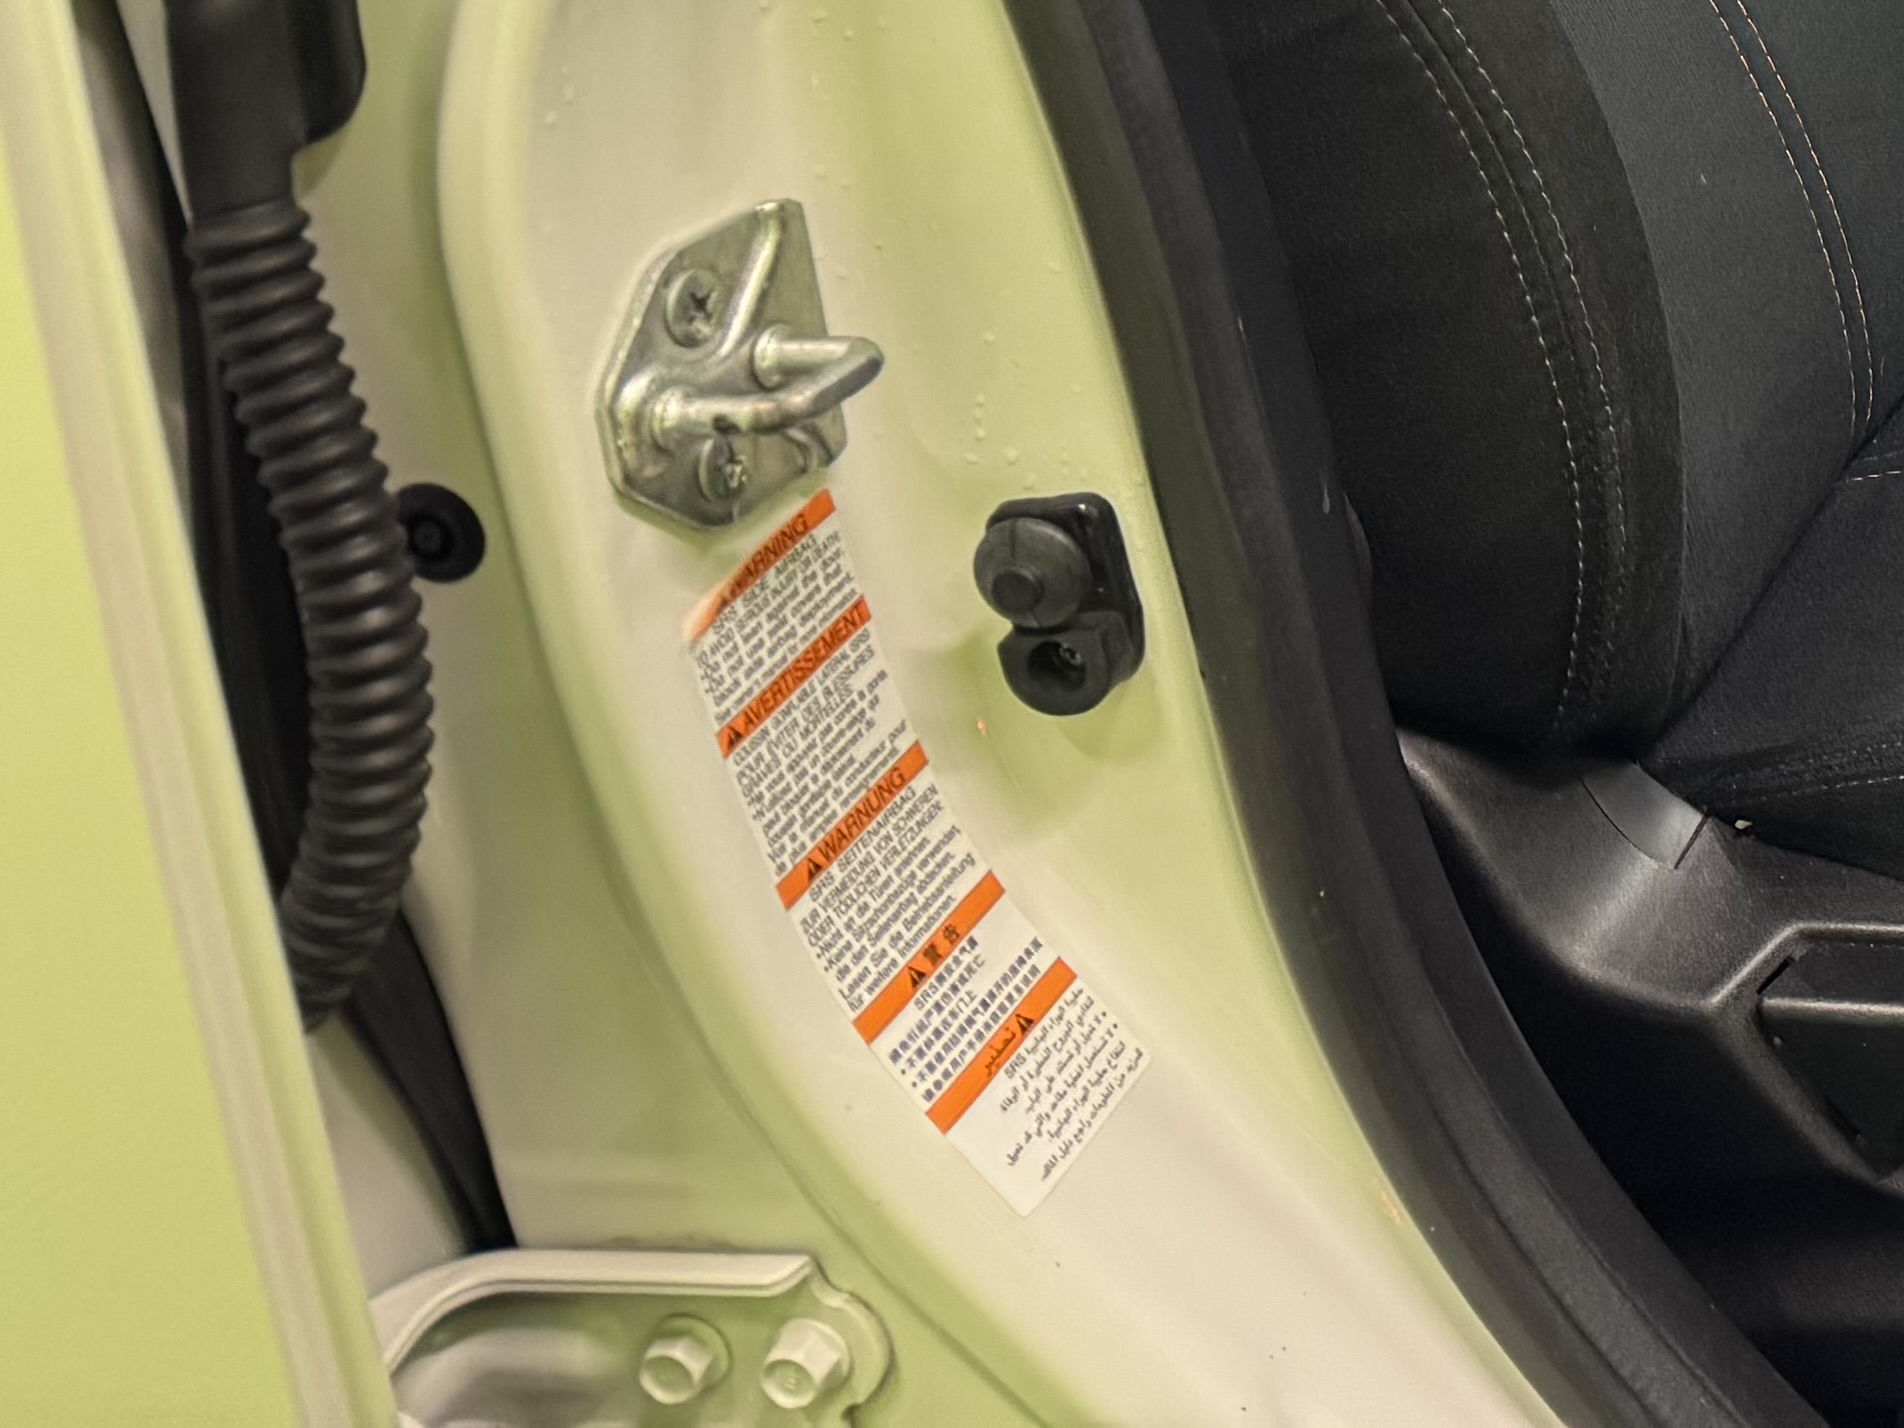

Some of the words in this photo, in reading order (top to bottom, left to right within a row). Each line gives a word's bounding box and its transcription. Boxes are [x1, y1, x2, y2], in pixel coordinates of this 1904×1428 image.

[739, 599, 867, 733] AVERTISSEMENT
[807, 869, 835, 904] SRS
[834, 784, 917, 875] SEITENAIRBAG
[817, 765, 906, 864] WARNUNG
[799, 906, 822, 936] ZUR
[818, 849, 876, 915] VERMEIDUNG
[872, 829, 894, 857] VON
[806, 912, 836, 949] ODER
[869, 943, 888, 969] Sie
